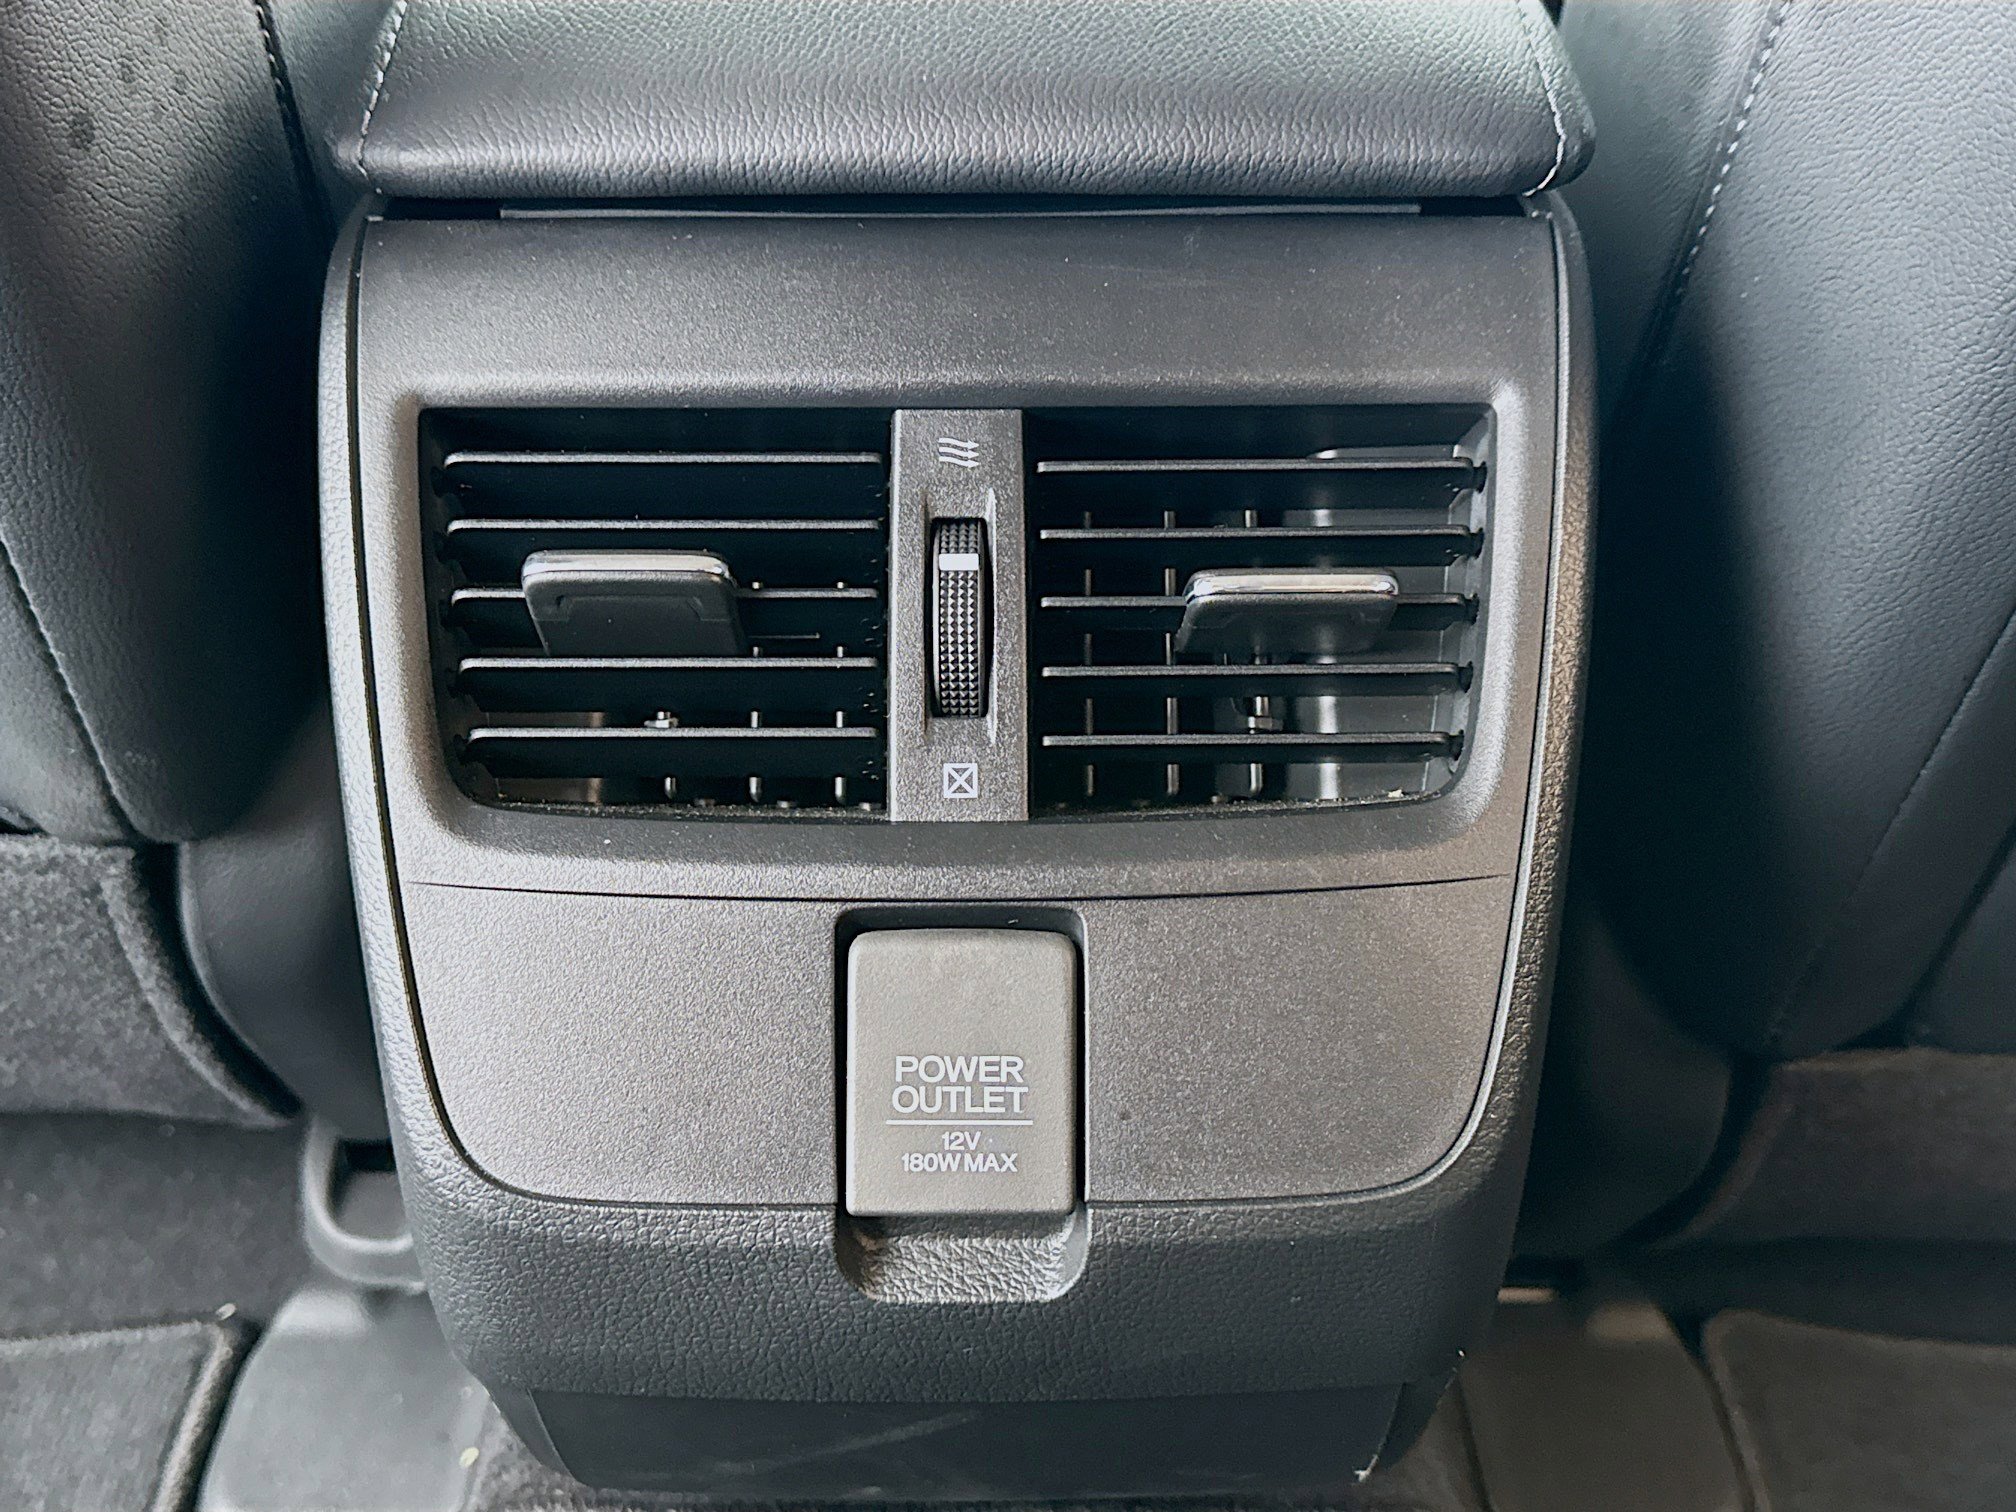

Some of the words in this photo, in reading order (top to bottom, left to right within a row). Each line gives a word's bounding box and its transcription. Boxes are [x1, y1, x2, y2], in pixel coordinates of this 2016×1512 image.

[895, 1055, 1024, 1083] POWER
[891, 1085, 1029, 1113] OUTLET
[941, 1131, 981, 1150] 12V
[901, 1153, 961, 1172] 180W
[964, 1153, 1018, 1172] MAX
